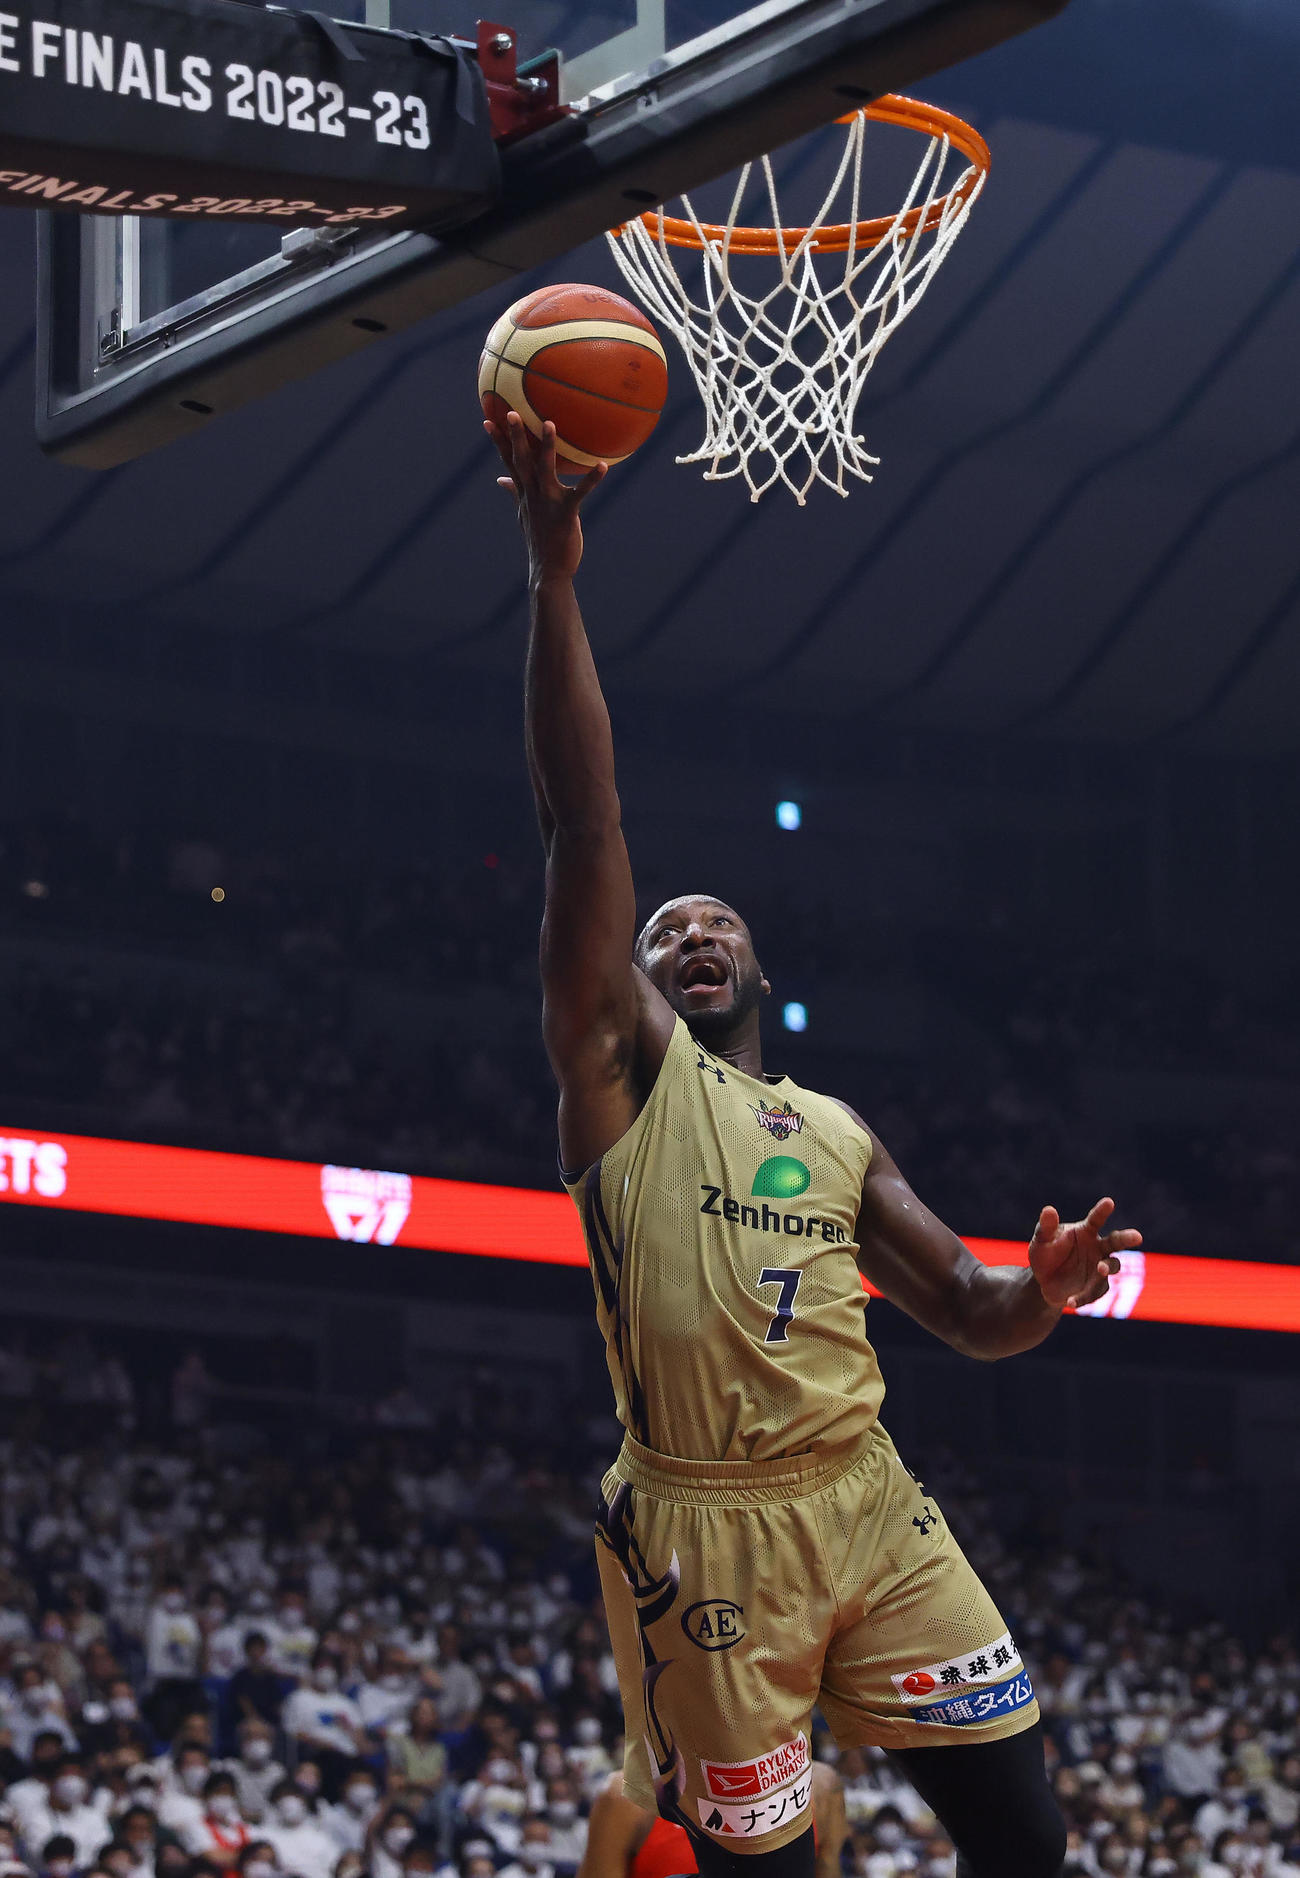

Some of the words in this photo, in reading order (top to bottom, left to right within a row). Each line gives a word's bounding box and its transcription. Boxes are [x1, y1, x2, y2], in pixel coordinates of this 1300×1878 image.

[32, 21, 213, 112] FINALS
[225, 63, 431, 151] 2022-23
[170, 196, 407, 223] 2022-23
[700, 1184, 852, 1245] Zenhoren
[757, 1267, 803, 1344] 7
[758, 1738, 806, 1777] RYUKYU
[761, 1751, 806, 1791] DAIHATSU
